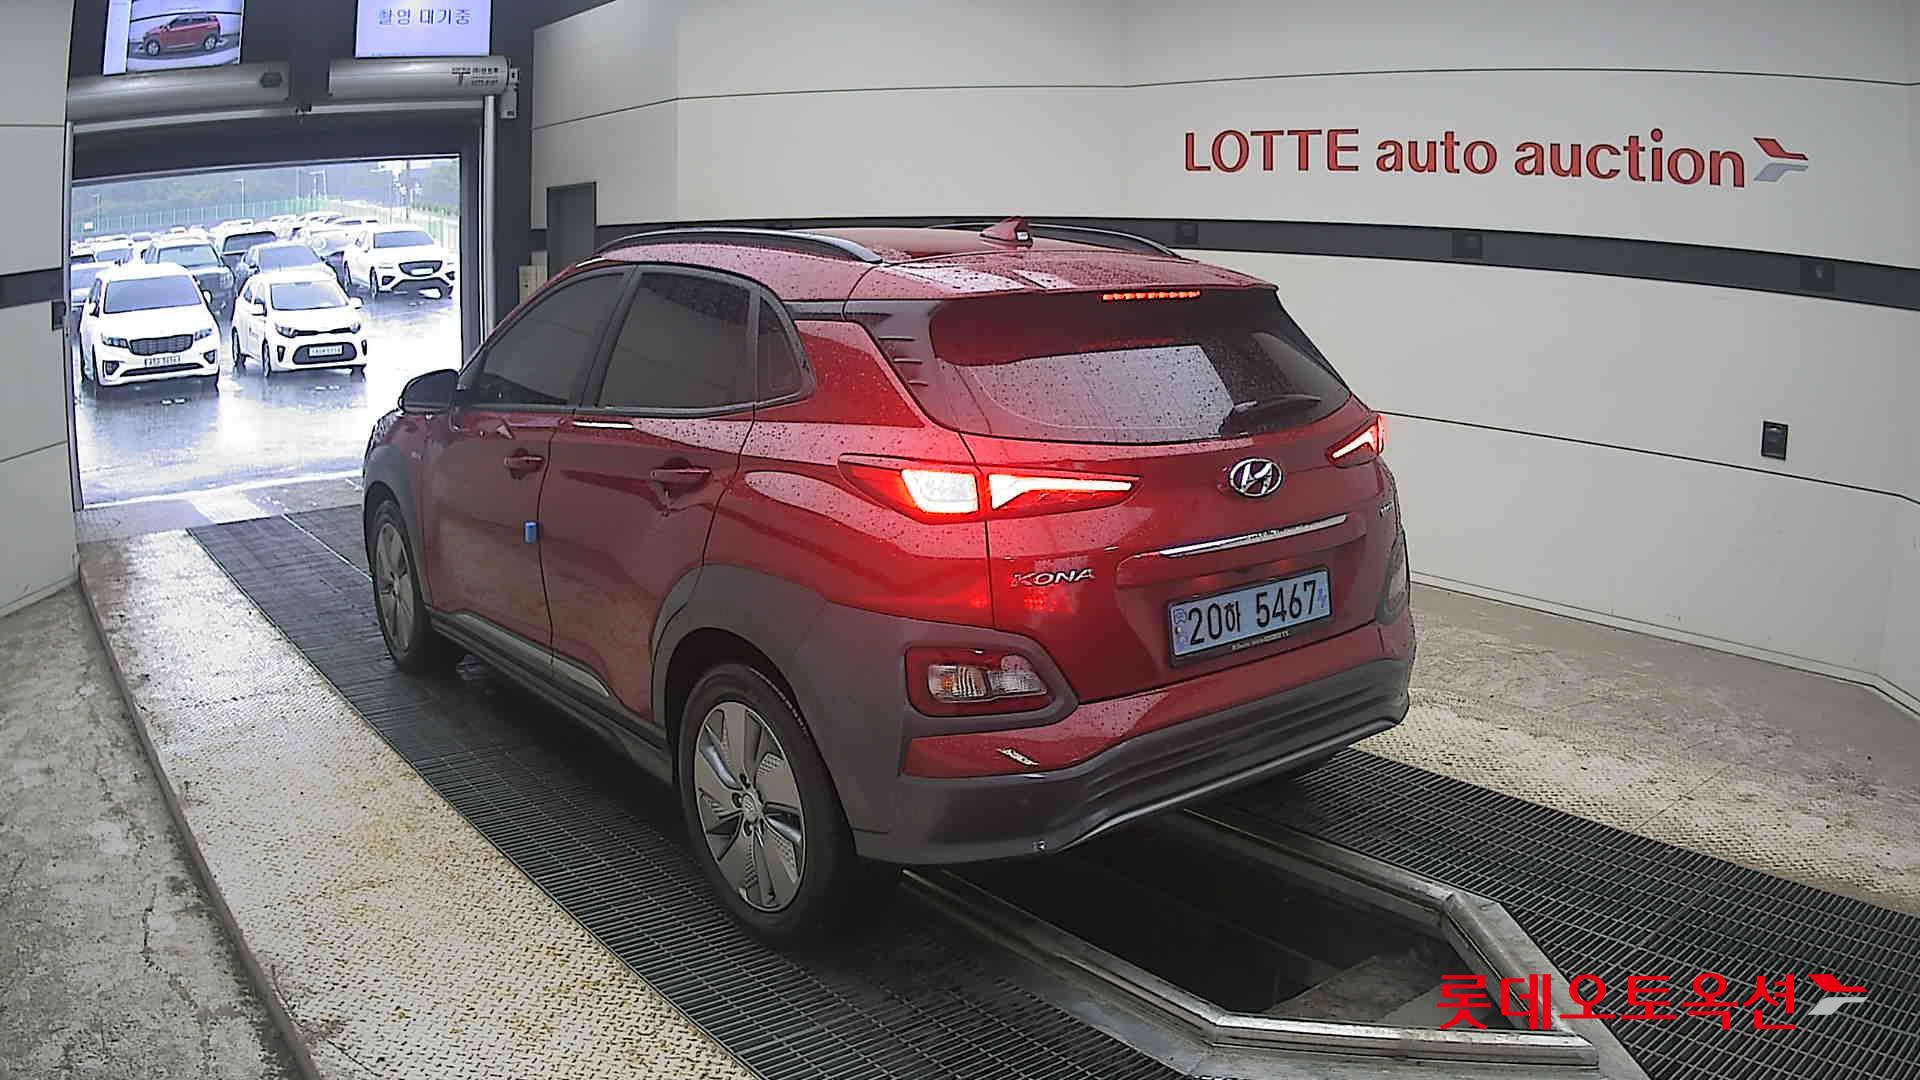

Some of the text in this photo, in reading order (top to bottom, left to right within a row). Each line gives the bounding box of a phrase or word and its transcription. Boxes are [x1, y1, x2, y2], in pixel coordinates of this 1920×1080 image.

[419, 7, 472, 25] 대기중
[1184, 128, 1745, 188] LOTTE auto auction
[1010, 568, 1096, 587] KONA
[1187, 600, 1241, 646] 20하
[1256, 579, 1317, 628] 5467
